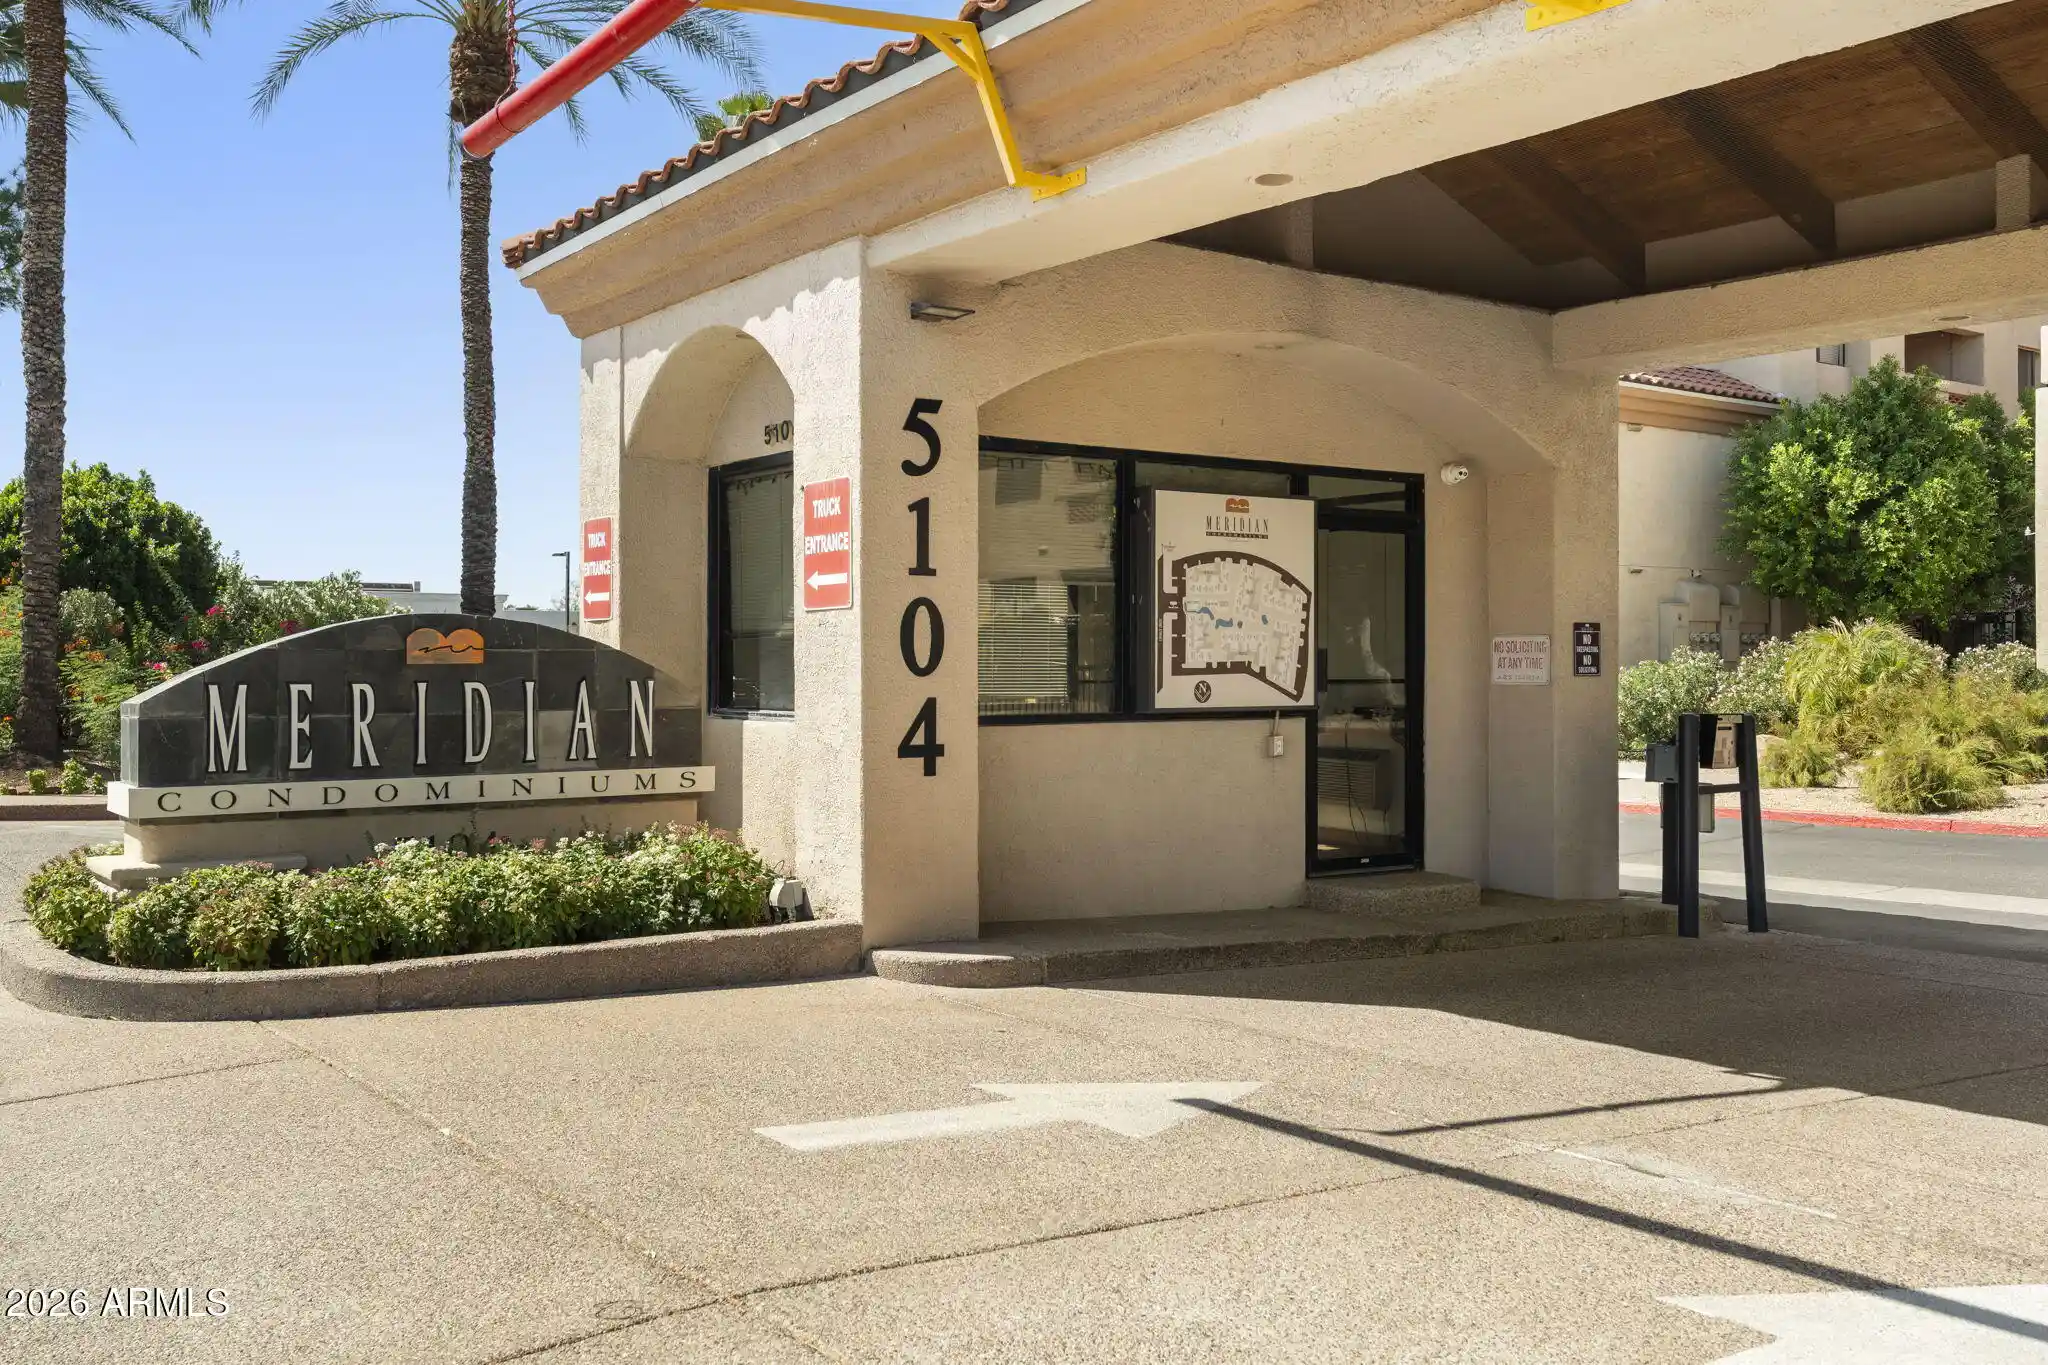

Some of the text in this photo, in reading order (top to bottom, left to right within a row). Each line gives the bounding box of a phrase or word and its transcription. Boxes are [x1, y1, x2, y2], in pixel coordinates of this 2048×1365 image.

[764, 420, 795, 445] 510
[812, 495, 841, 519] TRUCK
[1206, 515, 1269, 533] MERIDIAN
[588, 532, 606, 548] TRUCK
[804, 531, 849, 555] ENTRANCE
[583, 559, 611, 577] ENTRANCE
[898, 398, 945, 777] 5104
[1494, 640, 1548, 654] NO SOLICITING
[1582, 634, 1592, 645] NO
[1497, 656, 1544, 670] AT ANY TIME
[1582, 655, 1592, 666] NO
[206, 679, 656, 774] MERIDIAN
[157, 770, 697, 813] CONDOMINIUMS
